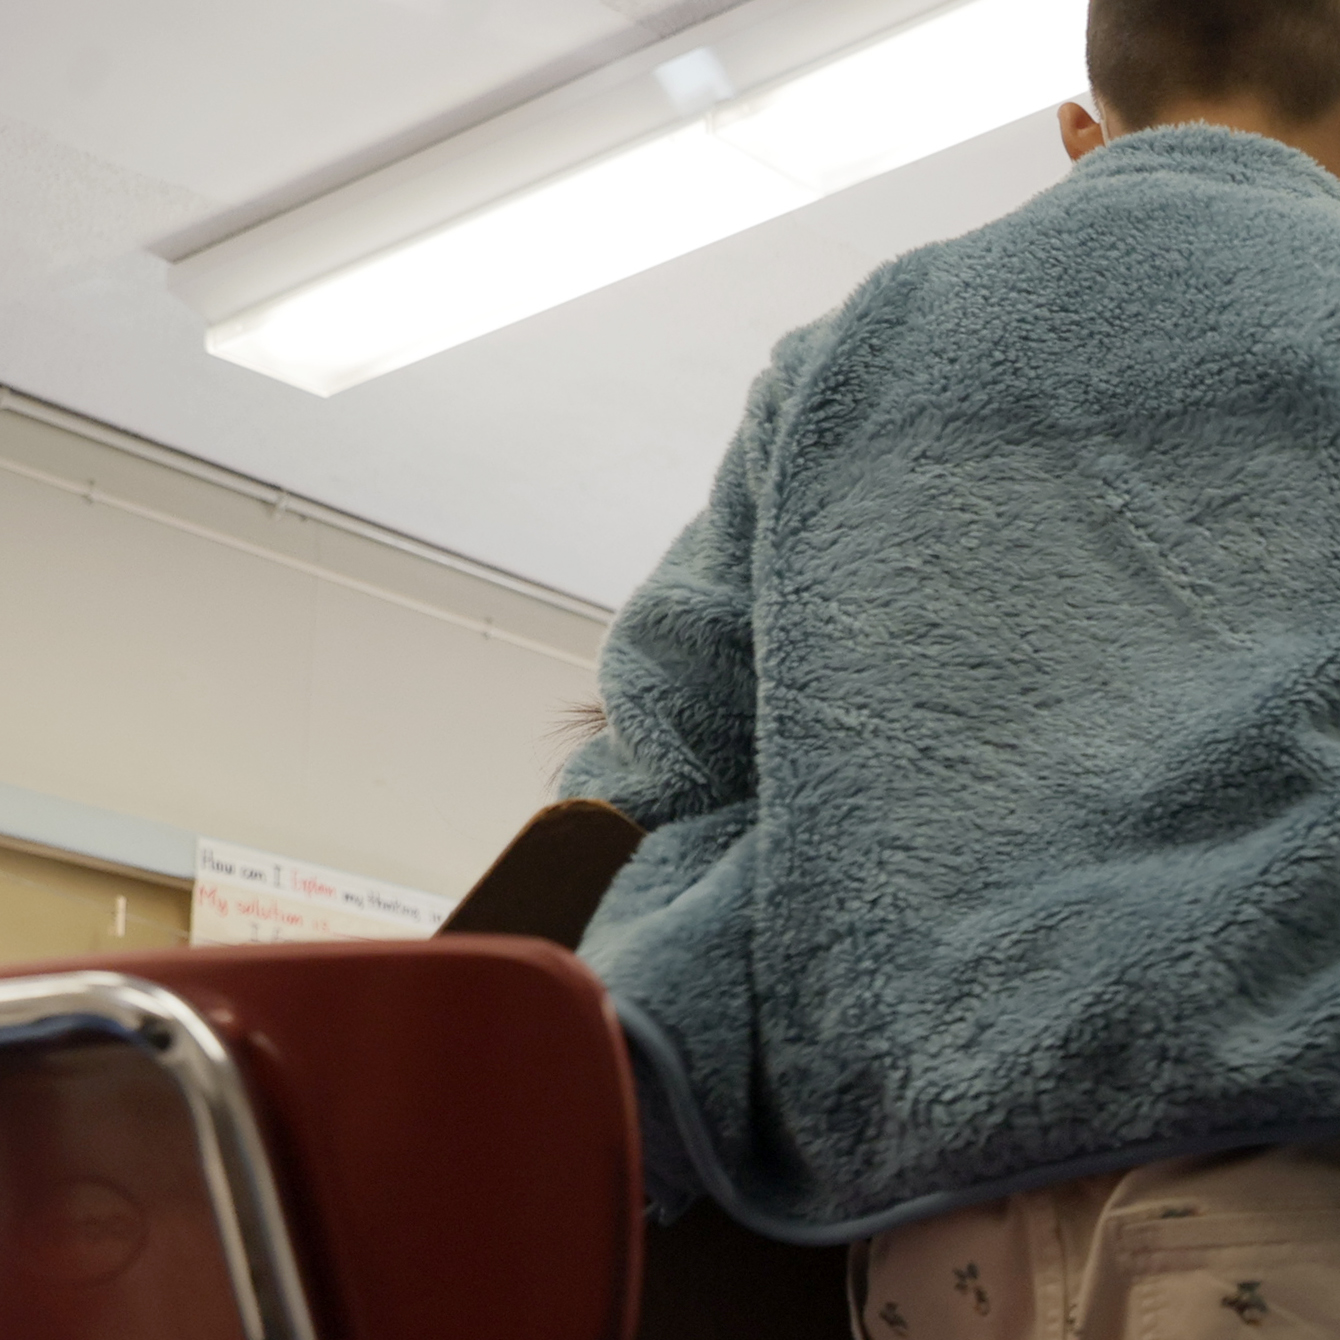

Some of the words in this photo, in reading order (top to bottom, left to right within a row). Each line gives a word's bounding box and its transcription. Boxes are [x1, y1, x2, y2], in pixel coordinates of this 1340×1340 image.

[201, 849, 236, 876] How
[240, 865, 268, 882] can
[274, 863, 282, 888] I
[343, 891, 365, 910] my
[197, 885, 229, 918] My
[237, 898, 303, 927] solution
